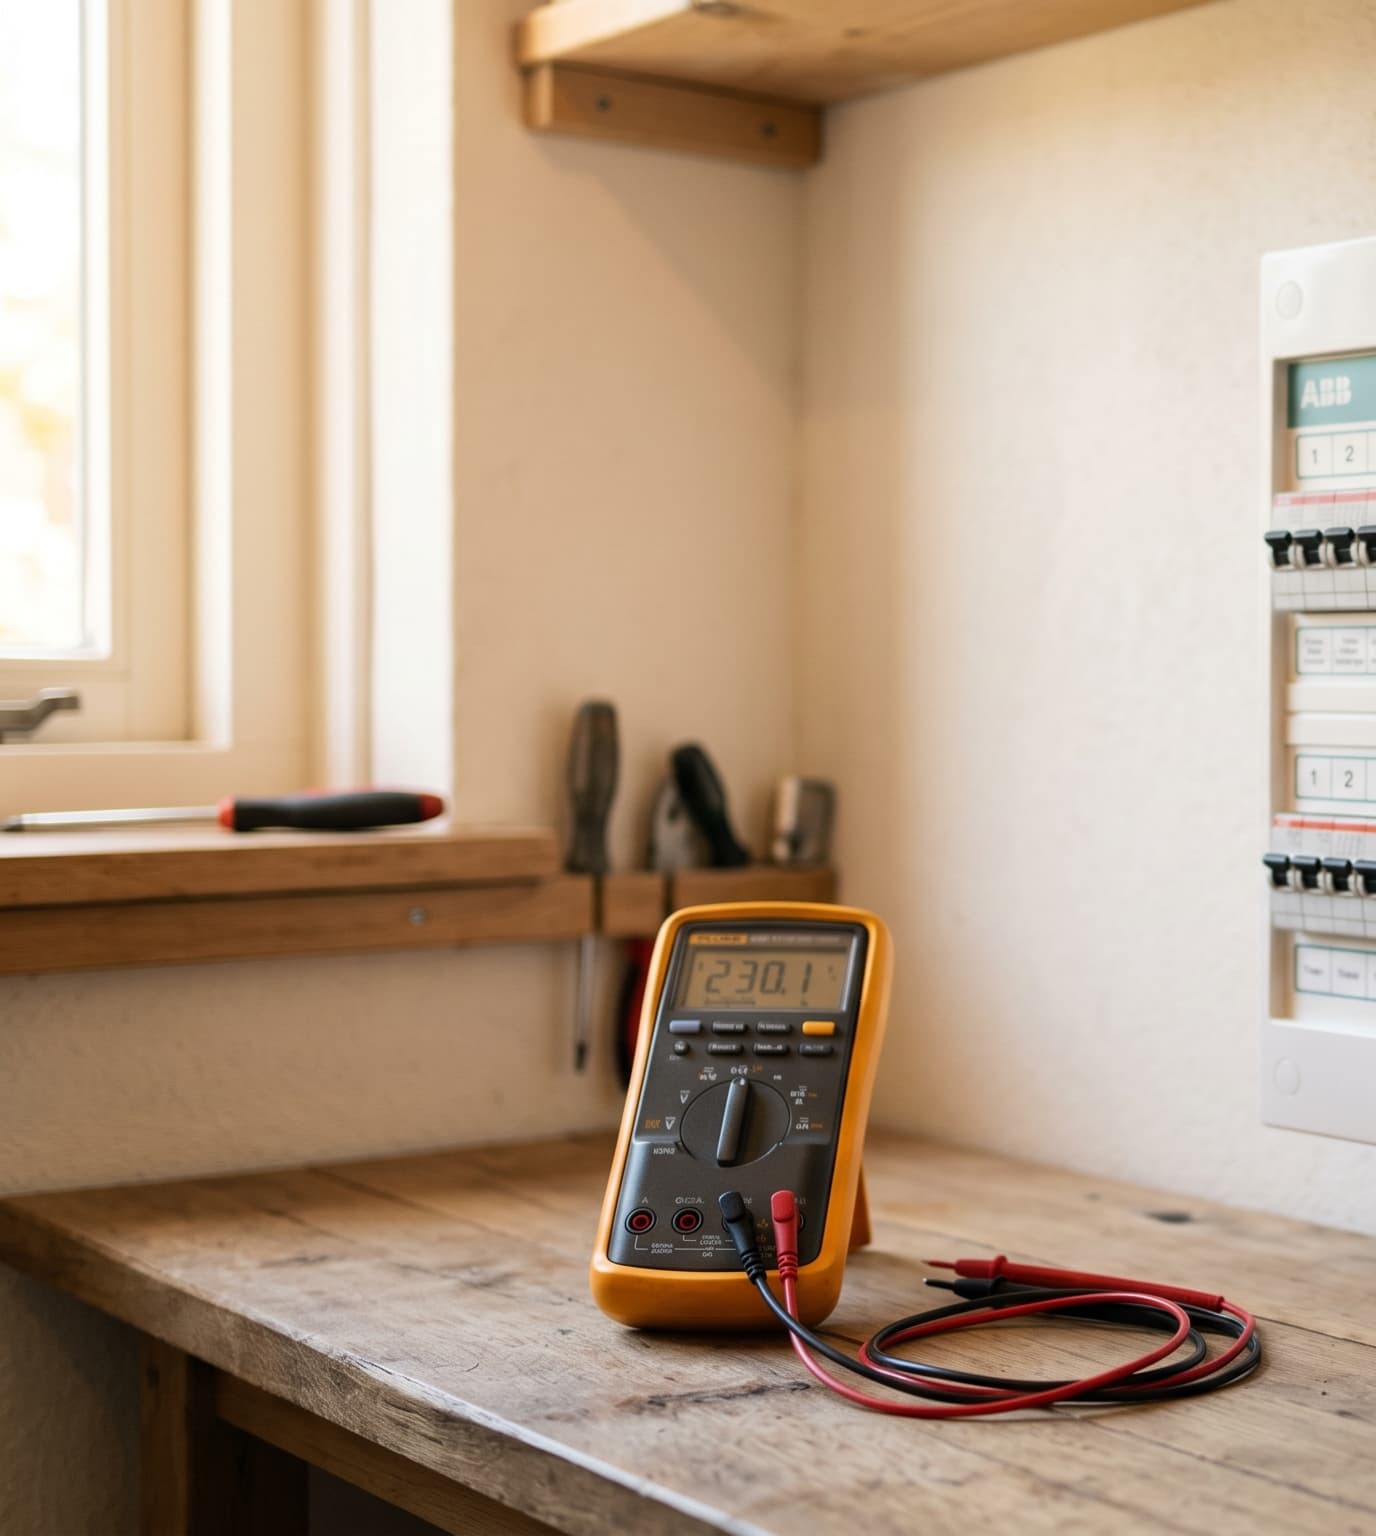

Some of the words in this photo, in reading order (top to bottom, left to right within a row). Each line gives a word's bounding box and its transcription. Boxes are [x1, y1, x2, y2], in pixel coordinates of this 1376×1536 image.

[1301, 376, 1352, 408] ABB
[1311, 448, 1318, 465] 1
[1345, 445, 1355, 463] 2
[1310, 769, 1317, 785] 1
[1344, 770, 1354, 788] 2
[704, 959, 813, 996] 230.1
